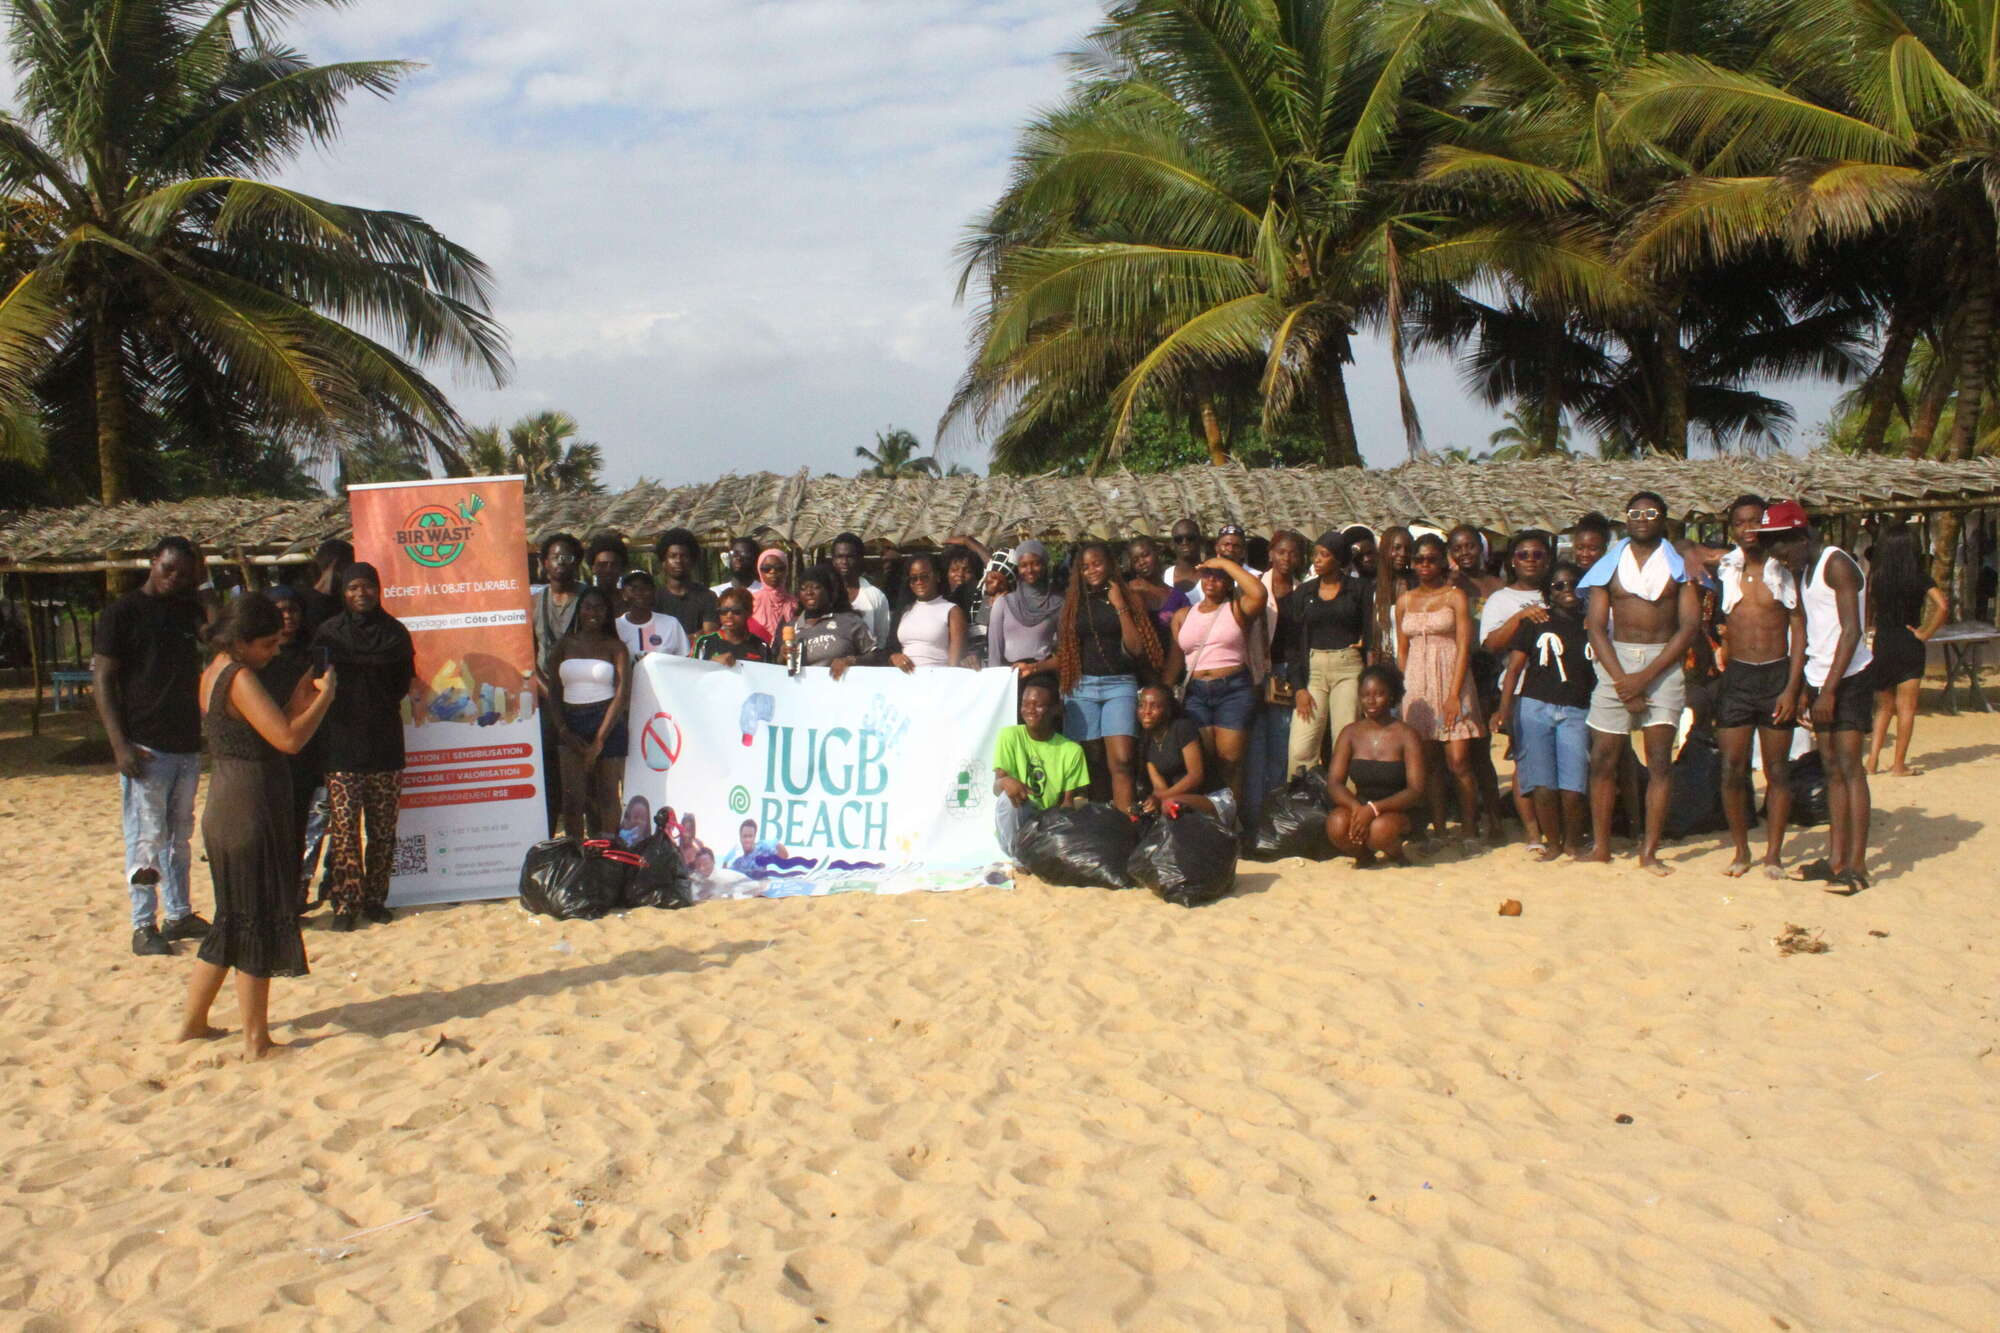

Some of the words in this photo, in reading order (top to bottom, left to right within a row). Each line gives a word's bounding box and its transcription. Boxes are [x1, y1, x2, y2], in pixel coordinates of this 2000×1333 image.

[396, 530, 424, 545] BIR
[425, 527, 471, 544] WAST
[383, 584, 420, 598] DÉCHET
[406, 617, 448, 630] cyclage
[464, 614, 488, 625] Côte
[490, 612, 525, 623] d'Ivoire
[404, 753, 439, 763] MATION
[765, 725, 889, 797] IUGB
[400, 774, 444, 786] CYCLAGE
[456, 768, 520, 780] VALORISATION
[491, 789, 509, 797] RSE
[760, 797, 889, 852] BEACH
